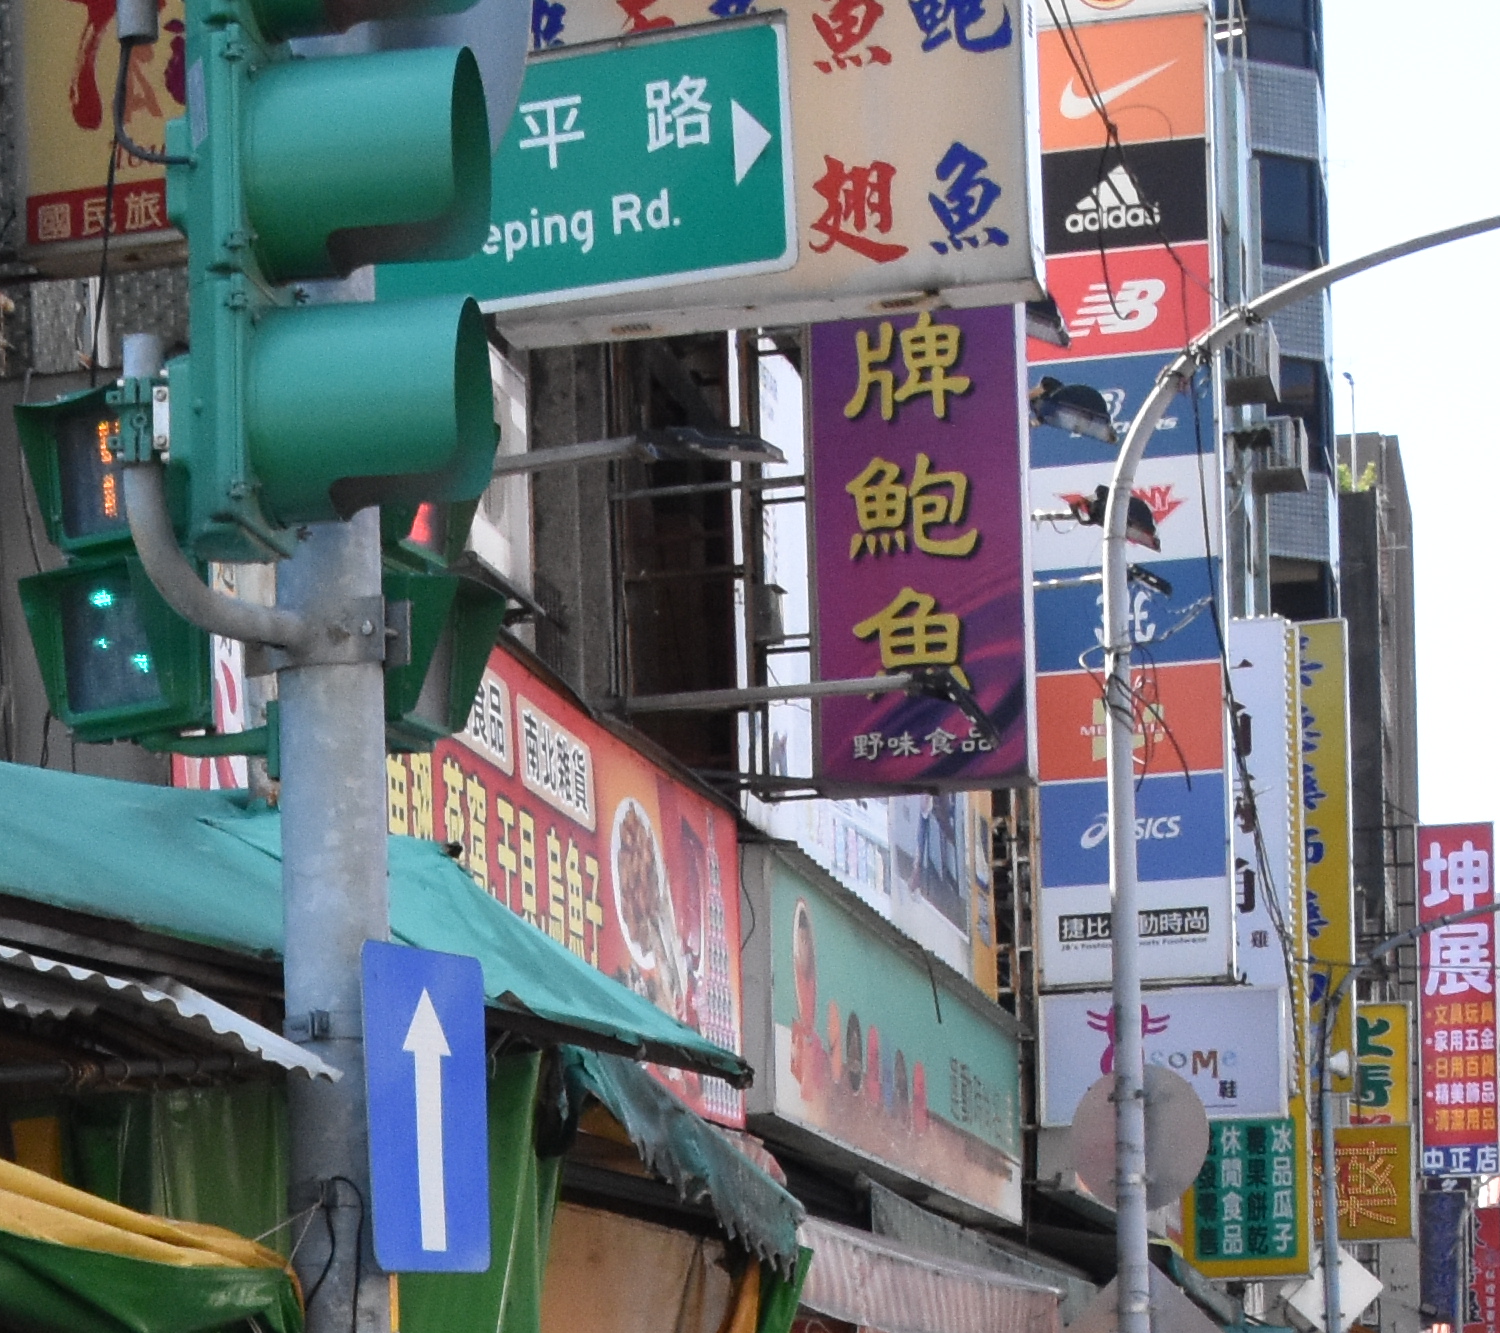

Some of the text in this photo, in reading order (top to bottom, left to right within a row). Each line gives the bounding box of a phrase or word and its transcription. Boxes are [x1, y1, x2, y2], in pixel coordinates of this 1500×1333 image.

[612, 188, 681, 235] Rd.
[1065, 201, 1161, 233] adidas
[852, 727, 996, 761] 野味食品
[520, 708, 591, 821] 南北雜貨
[1062, 909, 1208, 940] 捷比動時尚
[1422, 841, 1493, 997] 坤展
[1423, 1148, 1498, 1174] 中正店
[1271, 1124, 1294, 1252] 冰品瓜子
